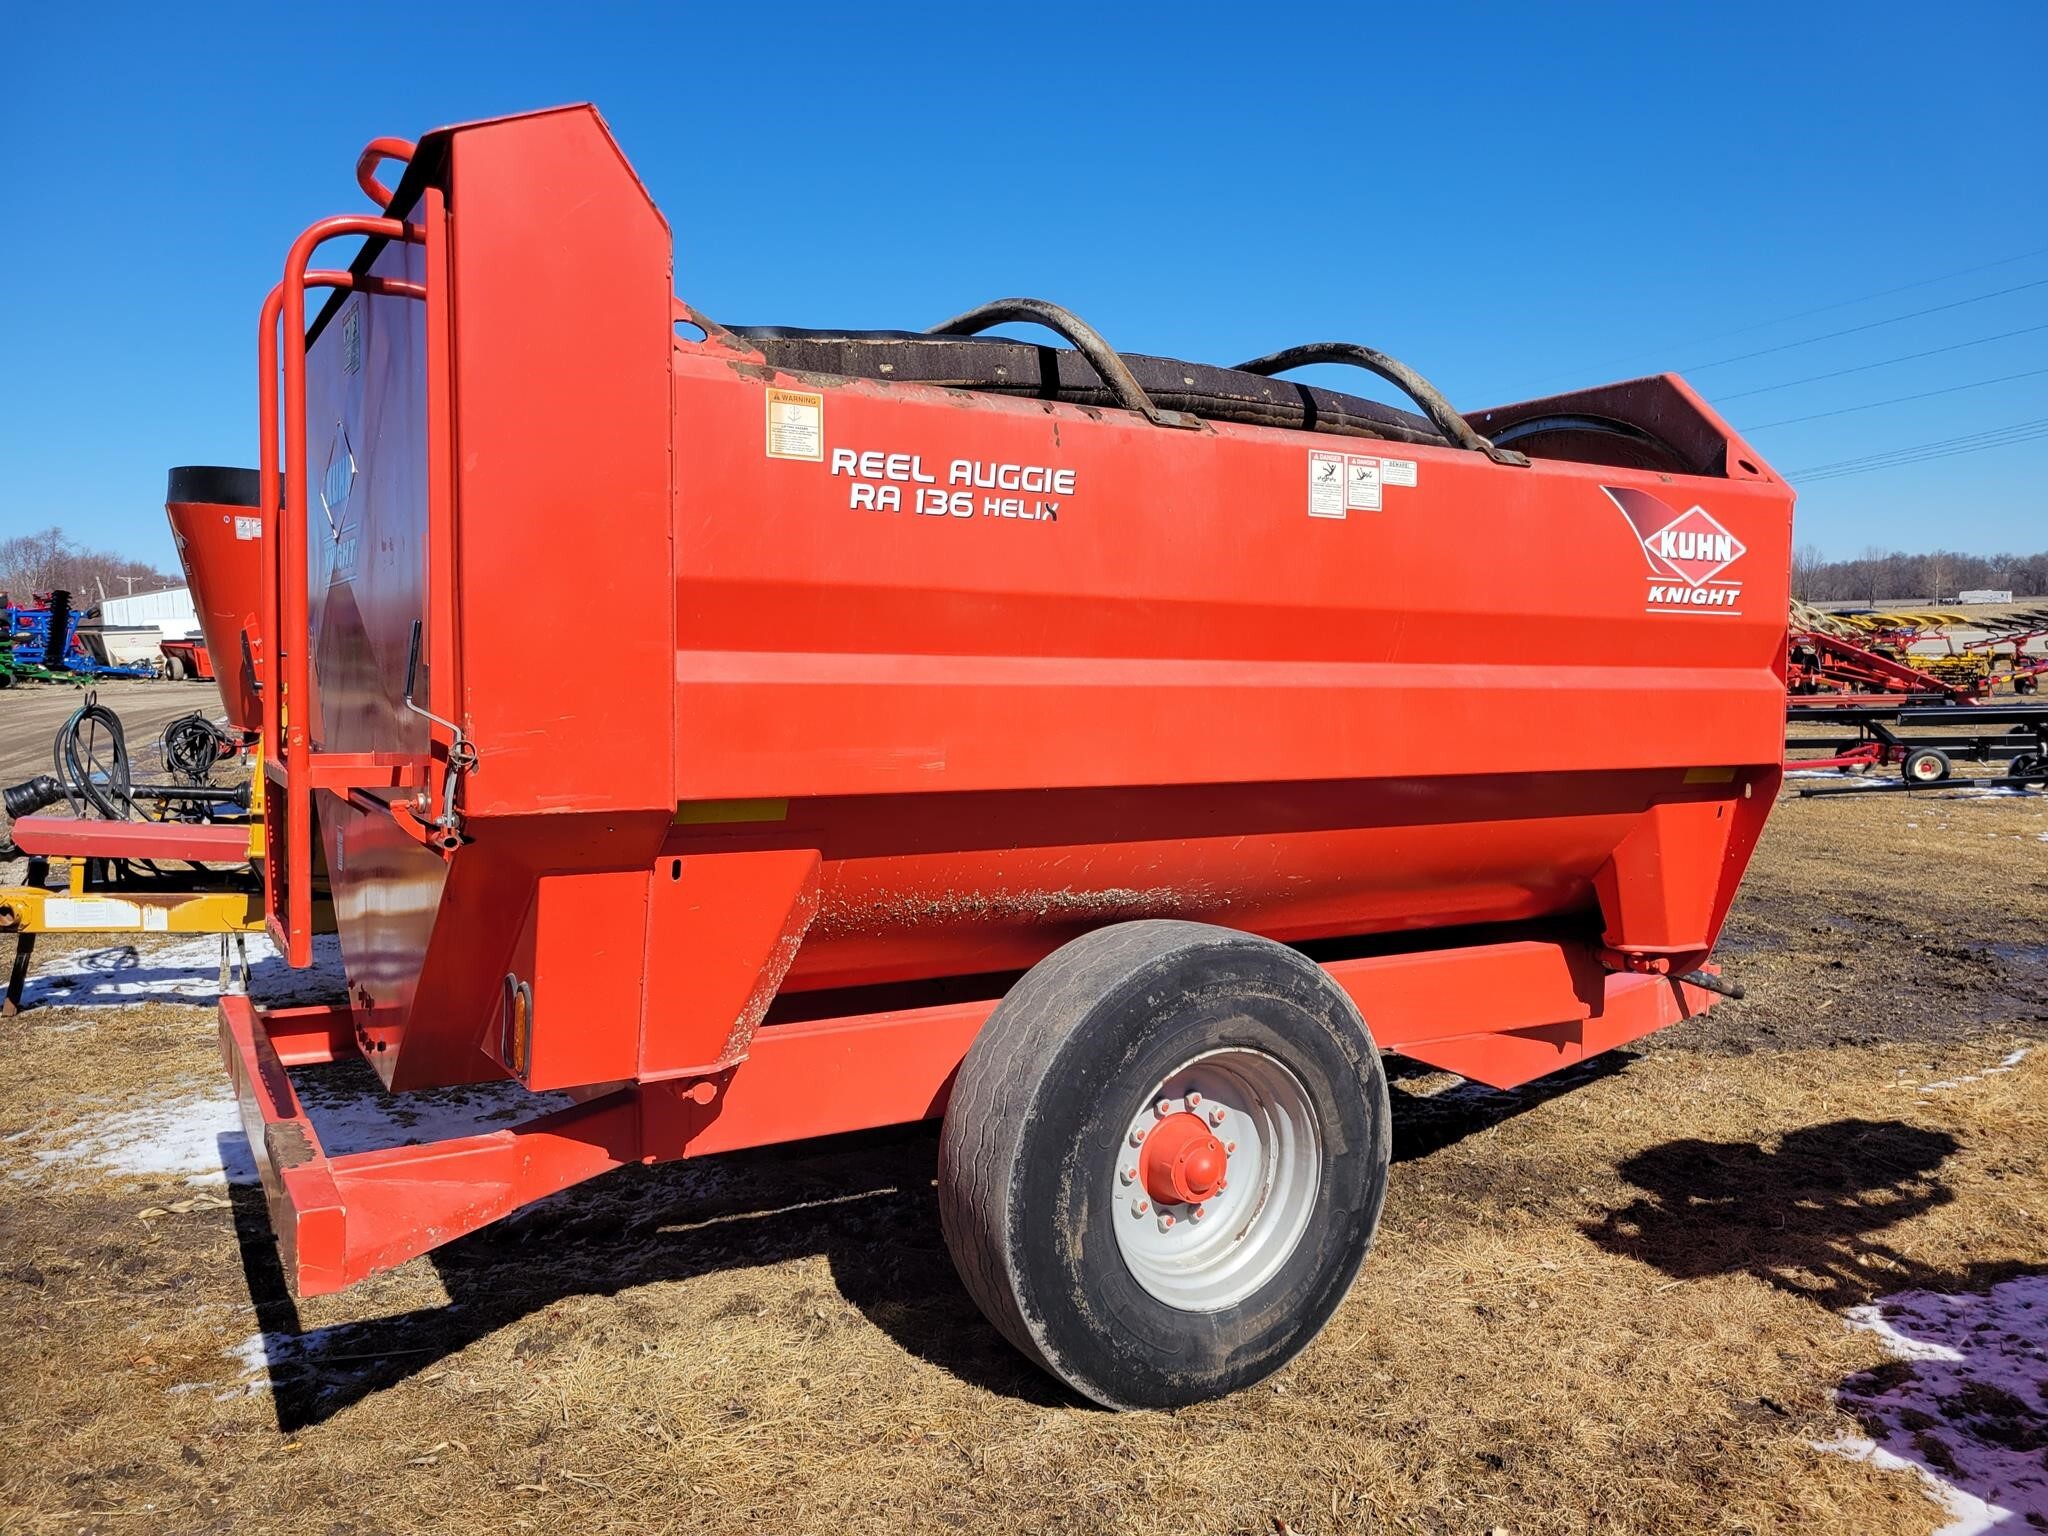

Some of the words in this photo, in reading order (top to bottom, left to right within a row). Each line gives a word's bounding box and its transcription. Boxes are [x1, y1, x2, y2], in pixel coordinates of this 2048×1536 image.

[781, 392, 817, 405] WARNING
[831, 447, 936, 484] REEL
[949, 459, 1078, 495] AUGGIE
[1319, 453, 1342, 462] DANGER
[850, 482, 902, 513] RA
[915, 488, 975, 518] 136
[983, 496, 1060, 522] HELIX
[1661, 529, 1732, 562] KUHN
[1647, 585, 1741, 607] KNIGHT
